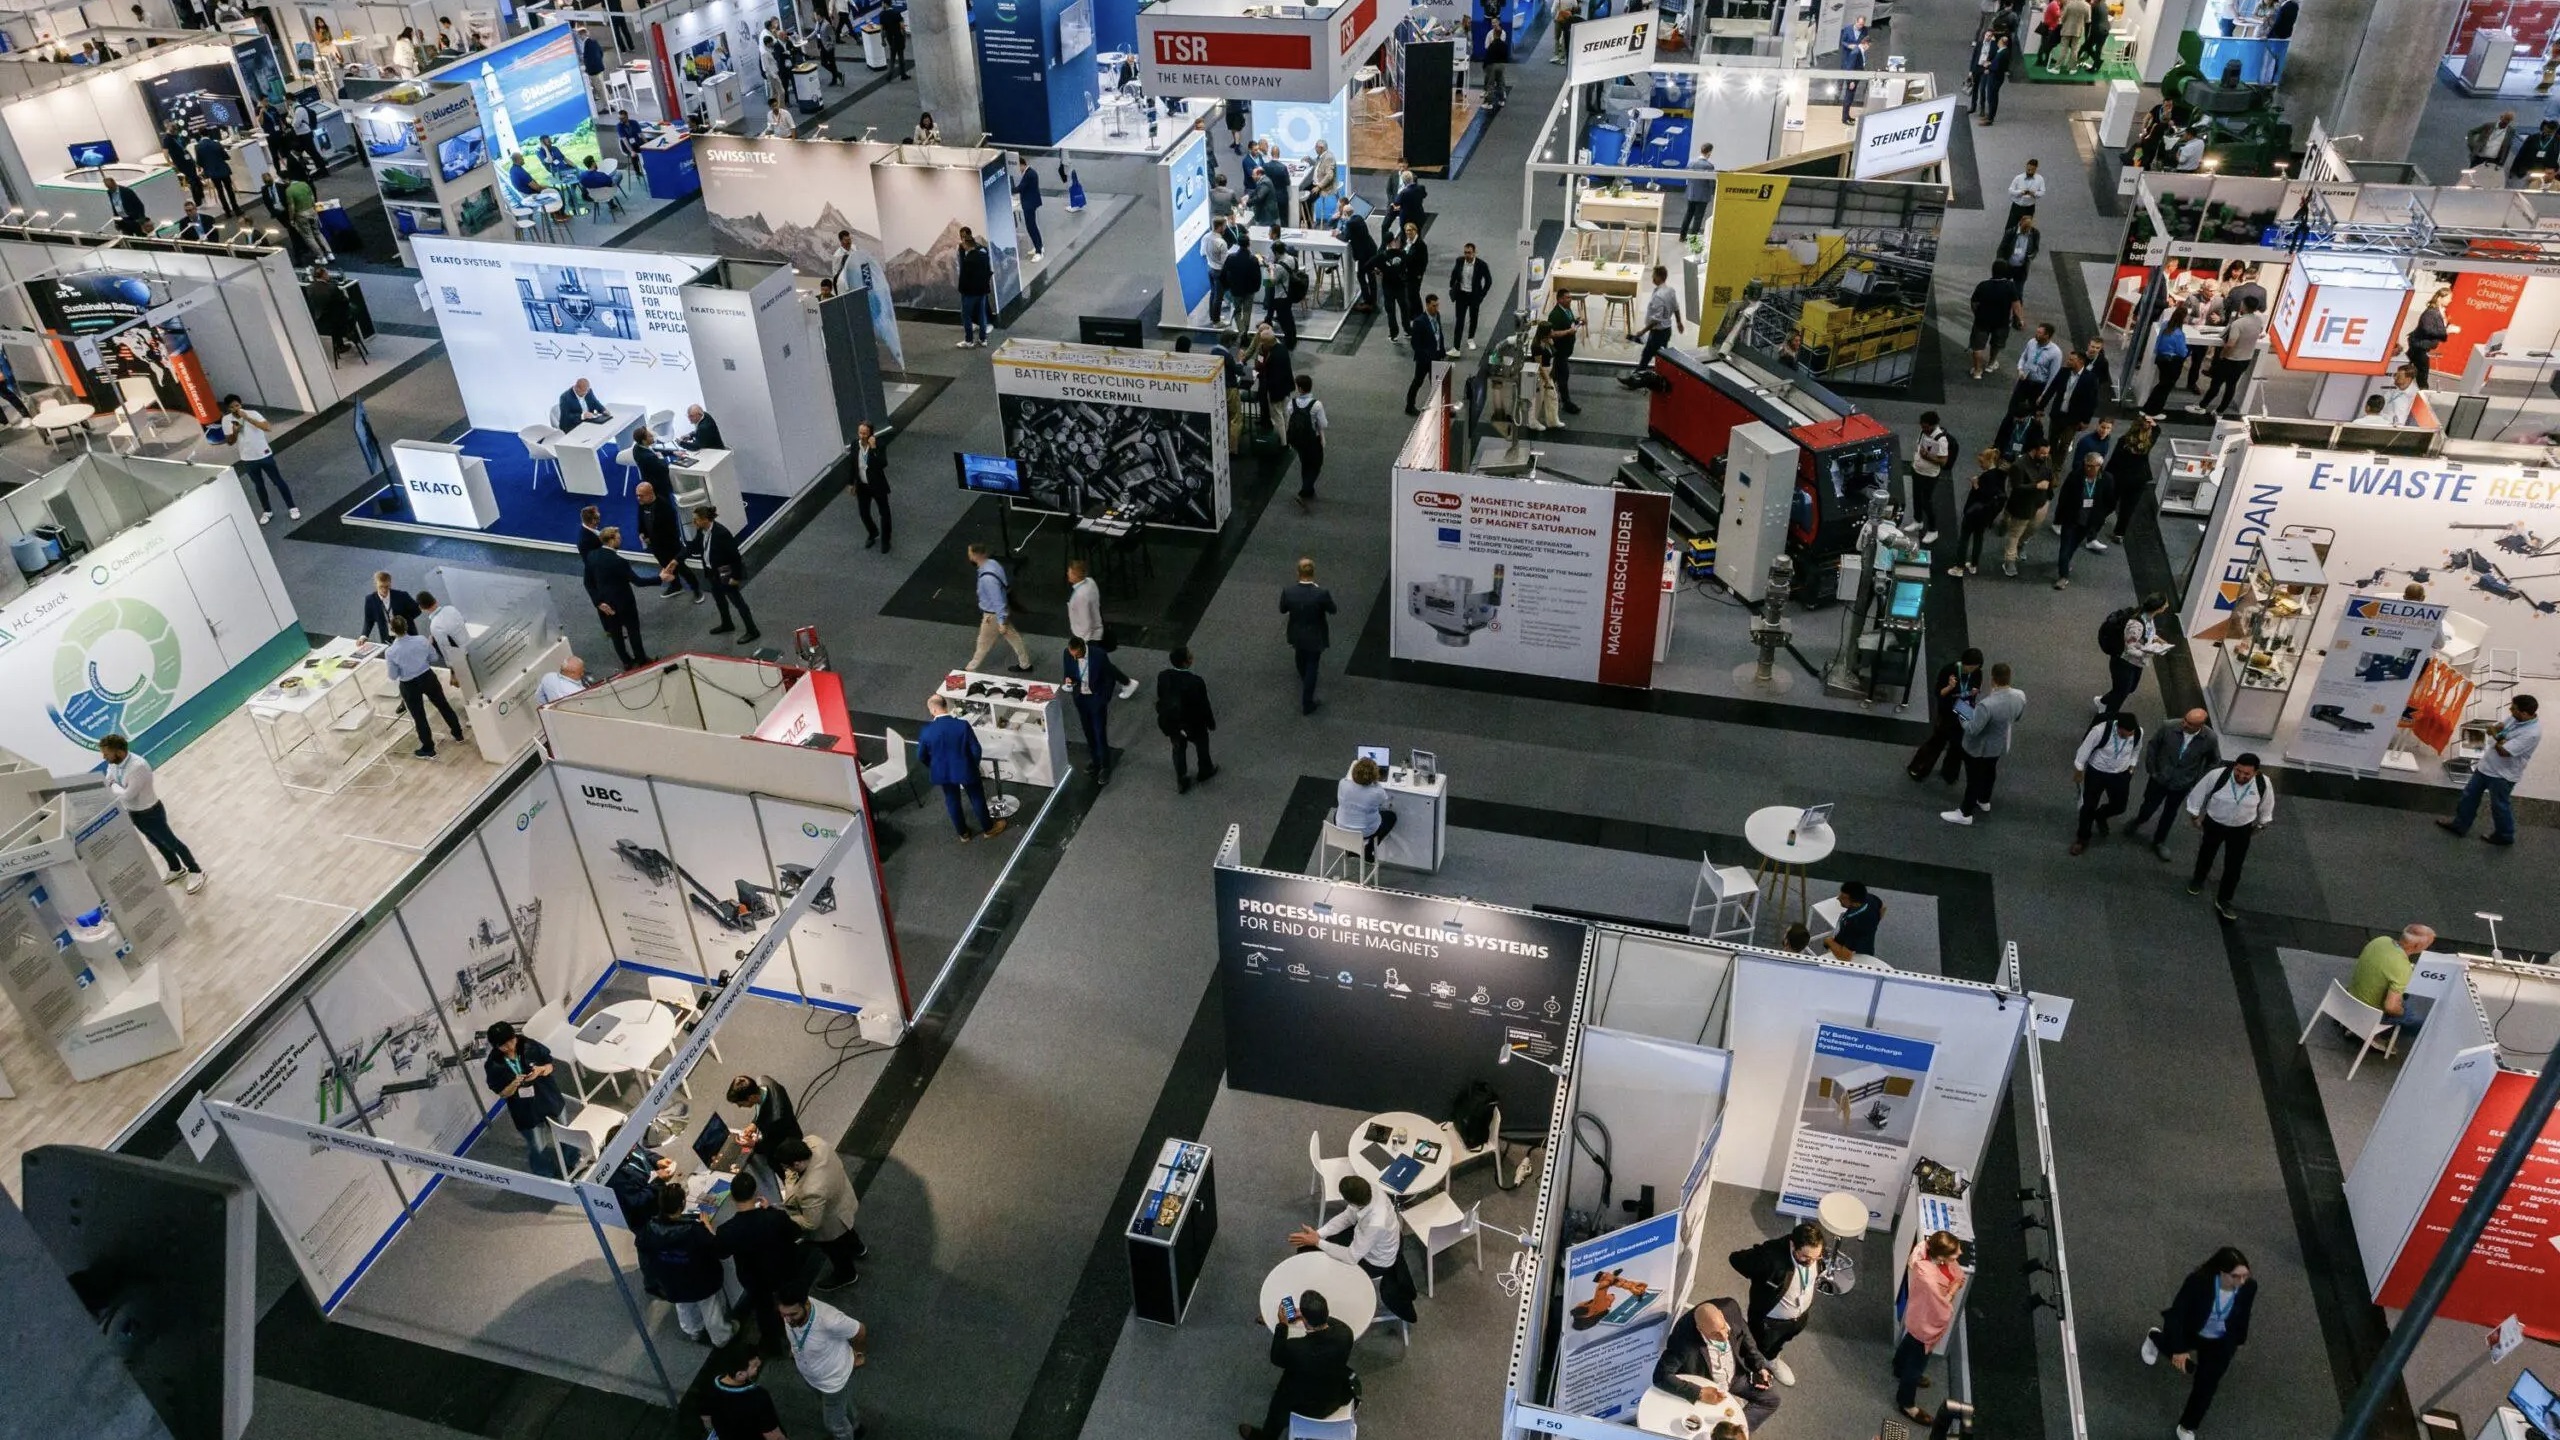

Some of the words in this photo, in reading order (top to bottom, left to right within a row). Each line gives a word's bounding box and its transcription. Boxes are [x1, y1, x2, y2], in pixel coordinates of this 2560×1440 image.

[1158, 34, 1208, 63] TSR
[1583, 36, 1629, 53] STEINERT
[1158, 72, 1177, 84] THE
[1183, 73, 1219, 87] METAL
[1225, 75, 1282, 88] COMPANY
[431, 98, 470, 120] bluetech
[1870, 126, 1921, 148] STEINERT
[1725, 186, 1759, 195] STEINERT
[430, 255, 461, 266] EKATO
[463, 257, 501, 268] SYSTEMS
[636, 271, 672, 284] DRYING
[2477, 277, 2519, 293] positive
[642, 296, 661, 307] FOR
[2476, 287, 2515, 303] change
[62, 303, 112, 314] Sustainable
[690, 306, 716, 315] EKATO
[716, 309, 747, 318] SYSTEMS
[2466, 297, 2510, 313] together
[2313, 308, 2369, 345] iFE
[1015, 368, 1068, 384] BATTERY
[1072, 372, 1145, 390] RECYCLING
[1149, 380, 1189, 394] PLANT
[1062, 386, 1143, 404] STOKKERMILL
[410, 480, 463, 496] EKATO
[2309, 462, 2477, 503] E-WASTE
[1470, 496, 1524, 508] MAGNETIC
[1527, 500, 1587, 515] SEPARATOR
[2484, 498, 2527, 508] COMPUTER
[2528, 501, 2556, 510] SCRAP
[1421, 510, 1462, 519] INNOVATION
[1470, 507, 1498, 516] WITH
[1500, 510, 1561, 522] INDICATION
[1470, 517, 1484, 525] OF
[1486, 518, 1528, 530] MAGNET
[1531, 522, 1596, 537] SATURATION
[2223, 484, 2284, 584] ELDAN
[1476, 541, 1502, 550] EUROPE
[1500, 536, 1534, 546] MAGNETIC
[1606, 511, 1634, 656] MAGNETABSCHEIDER
[12, 613, 36, 632] H.C.
[35, 590, 69, 618] Starck
[2379, 603, 2442, 621] ELDAN
[581, 784, 623, 803] UBC
[586, 799, 620, 812] Recycling
[620, 806, 639, 814] Line
[22, 849, 51, 862] Starck
[29, 895, 42, 909] 1
[1239, 898, 1352, 928] PROCESSING
[1356, 915, 1458, 944] RECYCLING
[1464, 934, 1549, 959] SYSTEMS
[1240, 916, 1269, 930] FOR
[1272, 921, 1304, 936] END
[1308, 925, 1327, 940] OF
[1332, 931, 1360, 946] LIFE
[1365, 935, 1440, 958] MAGNETS
[53, 938, 66, 953] 2
[75, 975, 89, 990] 3
[2420, 970, 2447, 981] G65
[653, 1083, 670, 1107] GET
[669, 1029, 711, 1083] RECYCLING
[714, 982, 746, 1023] TURNKEY
[745, 940, 776, 984] PROJECT
[2036, 1013, 2059, 1024] F50
[293, 1032, 318, 1058] Plastic
[1832, 1032, 1859, 1042] Battery
[1817, 1042, 1845, 1052] System
[1819, 1037, 1864, 1049] Professional
[1865, 1044, 1903, 1056] Discharge
[235, 1080, 259, 1104] Small
[259, 1044, 295, 1083] Appliance
[282, 1064, 299, 1082] Line
[2453, 1061, 2476, 1071] G72
[190, 1117, 206, 1138] E60
[306, 1131, 330, 1142] GET
[331, 1133, 396, 1158] RECYCLING
[404, 1153, 456, 1174] TURNKEY
[458, 1166, 512, 1186] PROJECT
[595, 1162, 611, 1185] E60
[593, 1199, 614, 1210] E60
[2519, 1201, 2540, 1209] FTIR
[2511, 1213, 2549, 1225] BINDER
[2500, 1228, 2539, 1239] CONTENT
[1571, 1259, 1593, 1270] Robot
[1594, 1252, 1616, 1264] based
[1616, 1235, 1660, 1254] Disassembly
[1583, 1248, 1609, 1260] Battery
[2487, 1244, 2510, 1254] FOIL
